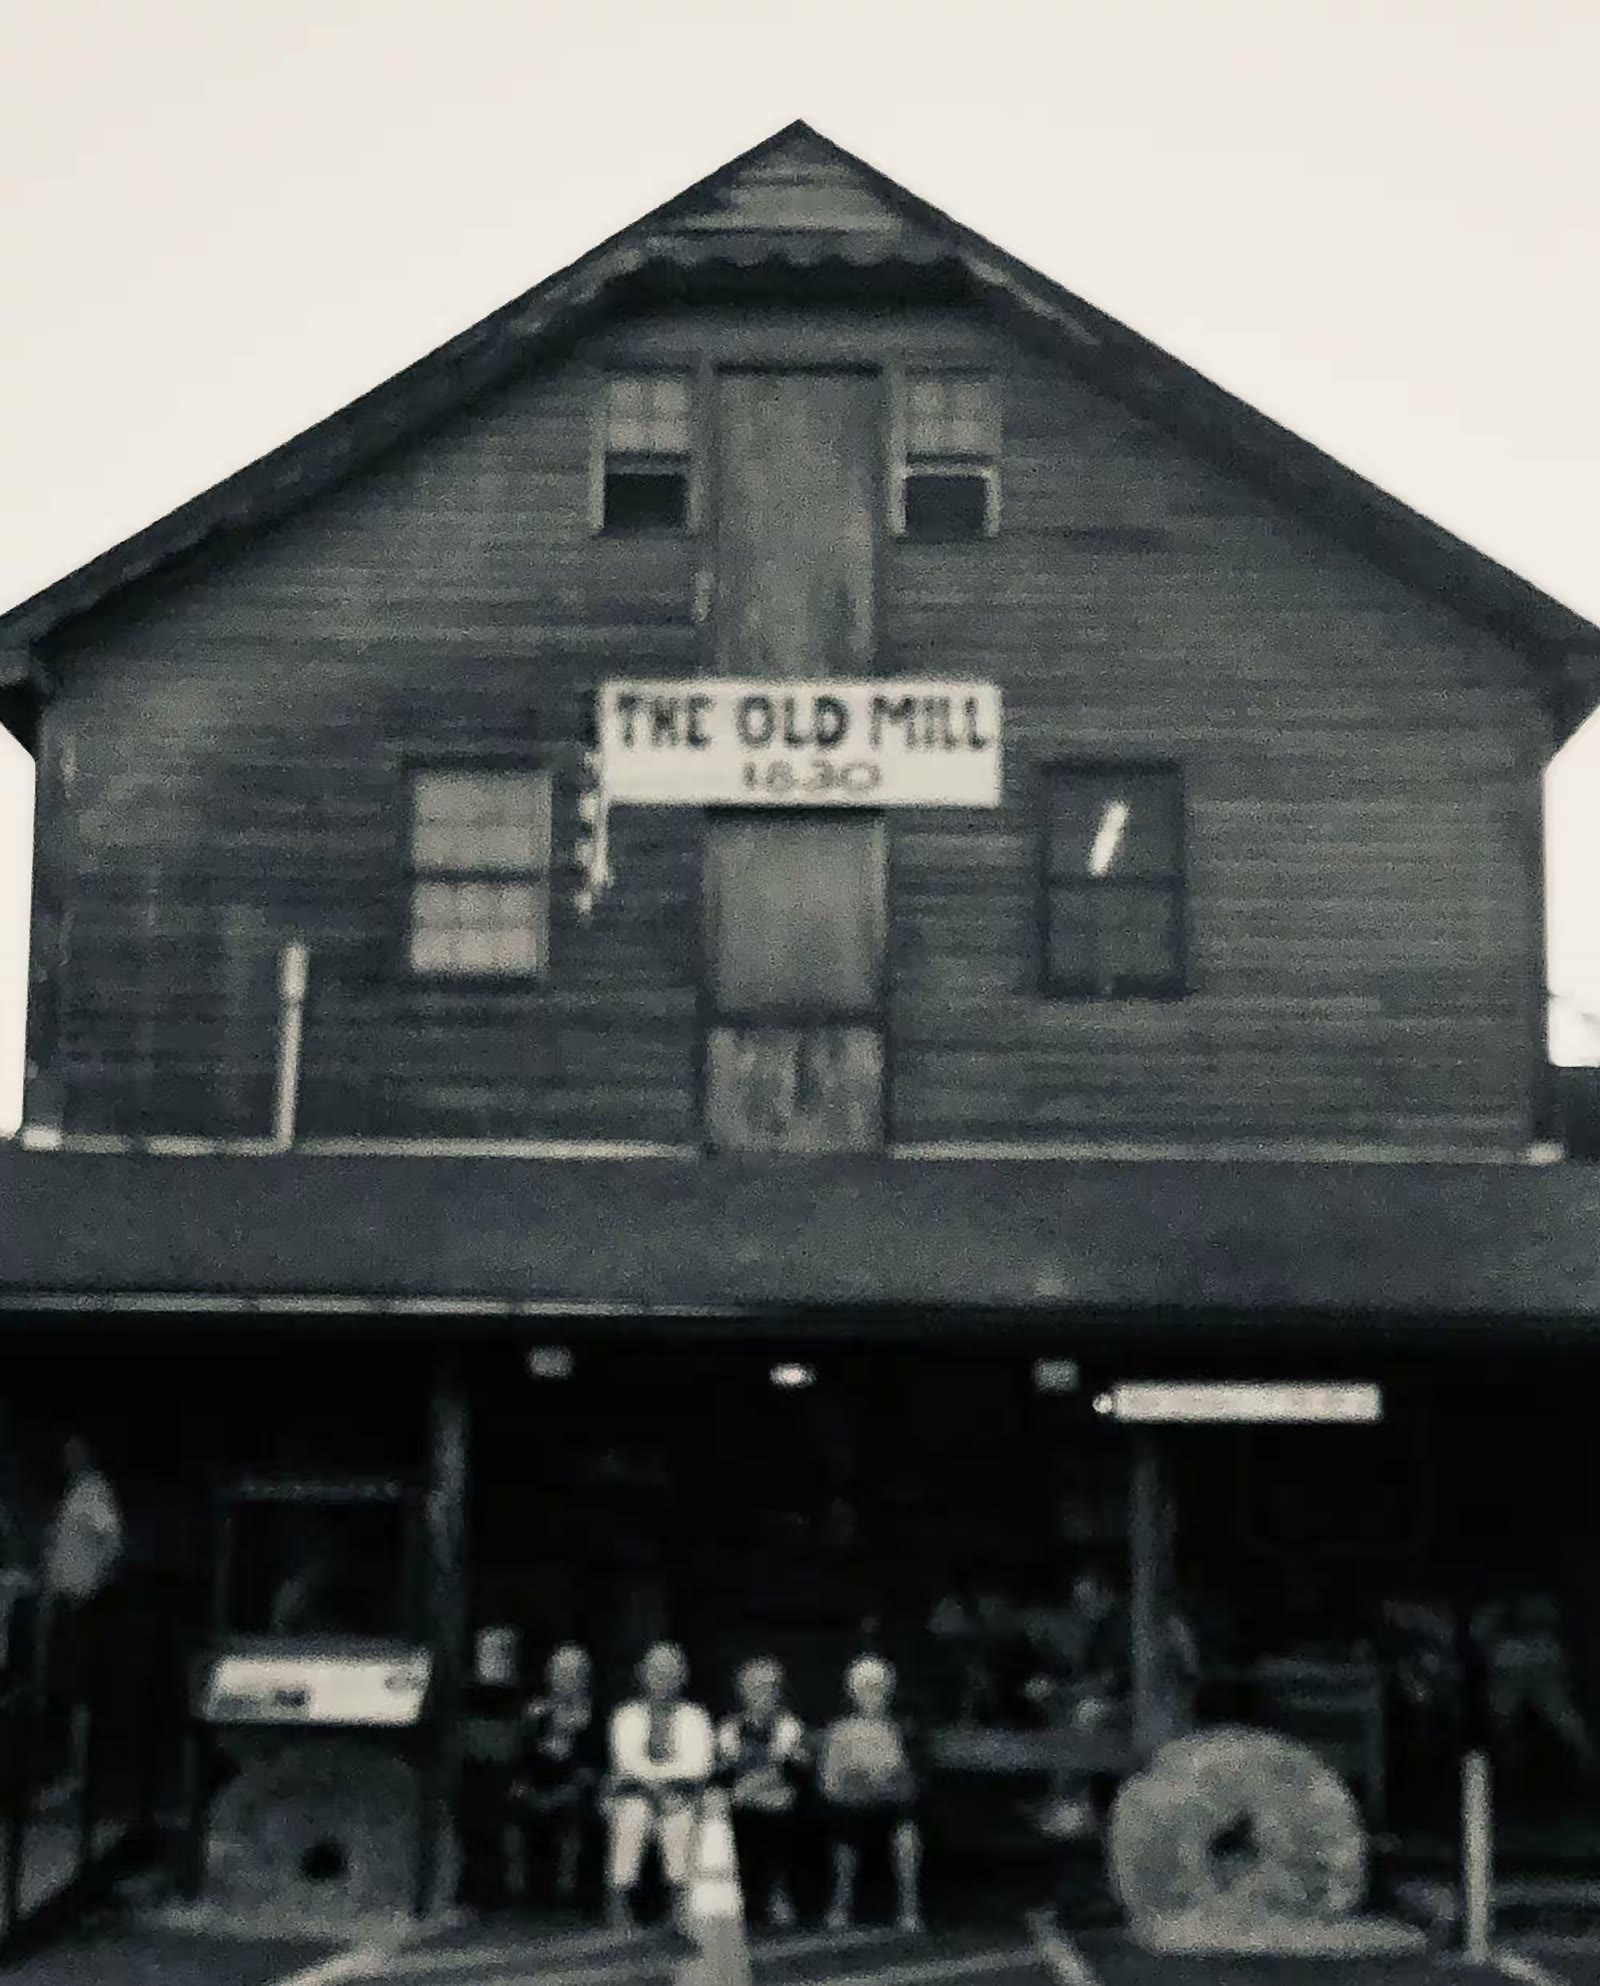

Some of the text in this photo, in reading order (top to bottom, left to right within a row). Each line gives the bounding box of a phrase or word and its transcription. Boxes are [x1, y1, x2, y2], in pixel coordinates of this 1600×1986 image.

[616, 693, 994, 751] THE OLD MILL
